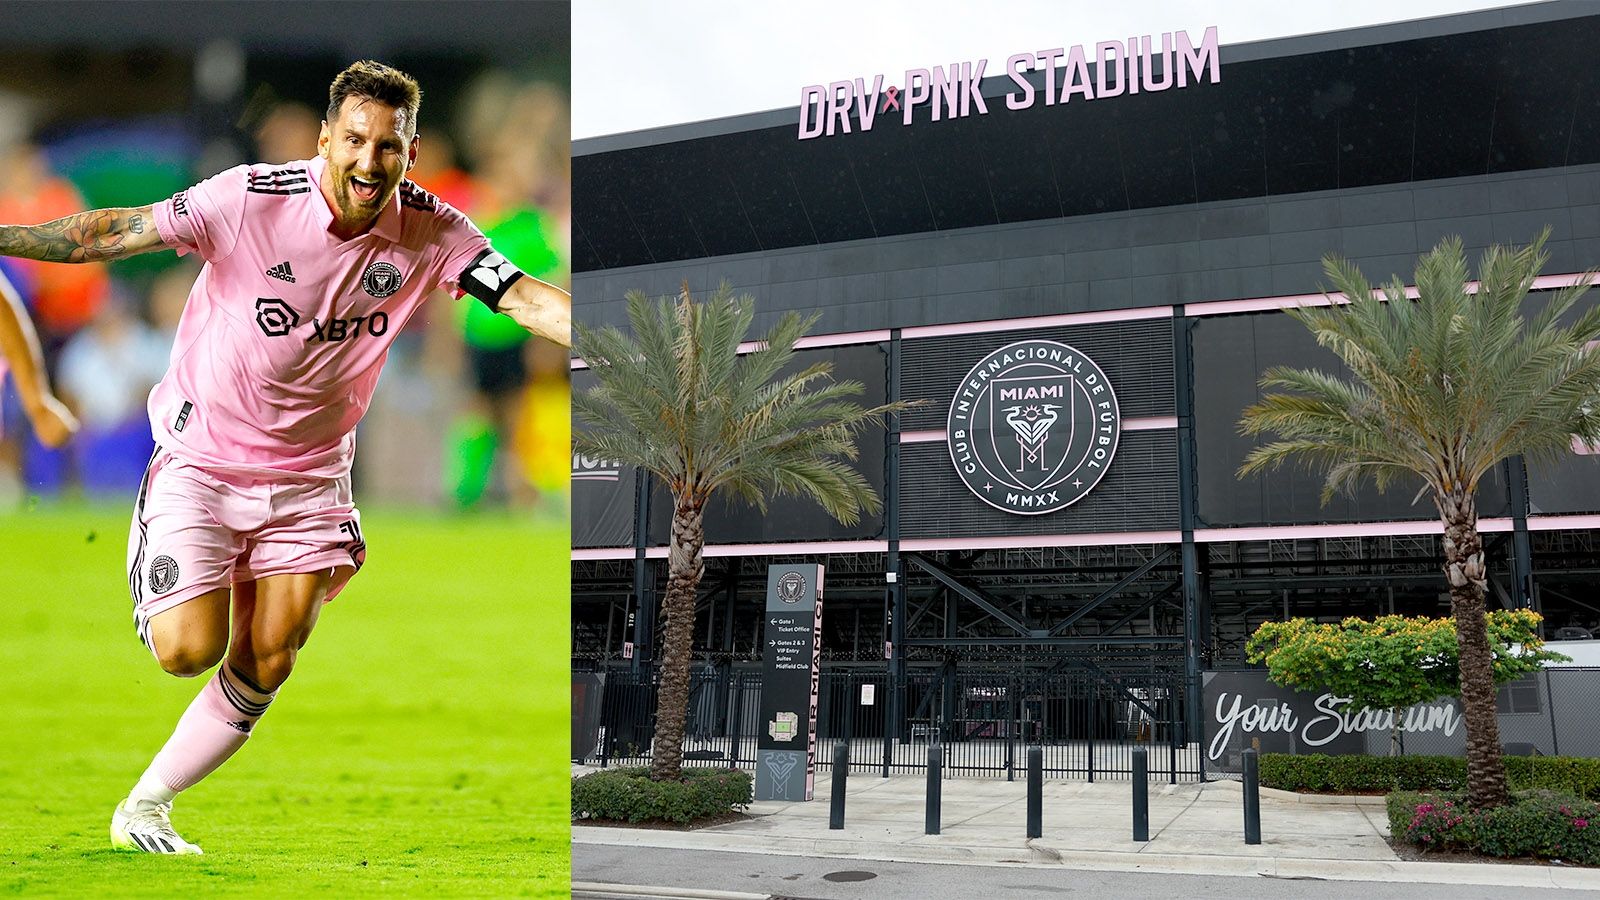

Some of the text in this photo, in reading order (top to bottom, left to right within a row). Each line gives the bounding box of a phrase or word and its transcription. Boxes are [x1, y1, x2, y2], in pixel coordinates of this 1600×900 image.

[798, 25, 1221, 140] DRV PNK STADIUM
[266, 269, 296, 284] adidas
[306, 311, 389, 342] XBTO
[955, 348, 1115, 474] CLUB INTERNACIONAL DE FÚTBOL
[1000, 385, 1064, 401] MIAMI
[1005, 490, 1060, 507] MMXX
[807, 589, 822, 774] INTER MIAMI CF
[1208, 691, 1463, 760] Your Stadum
